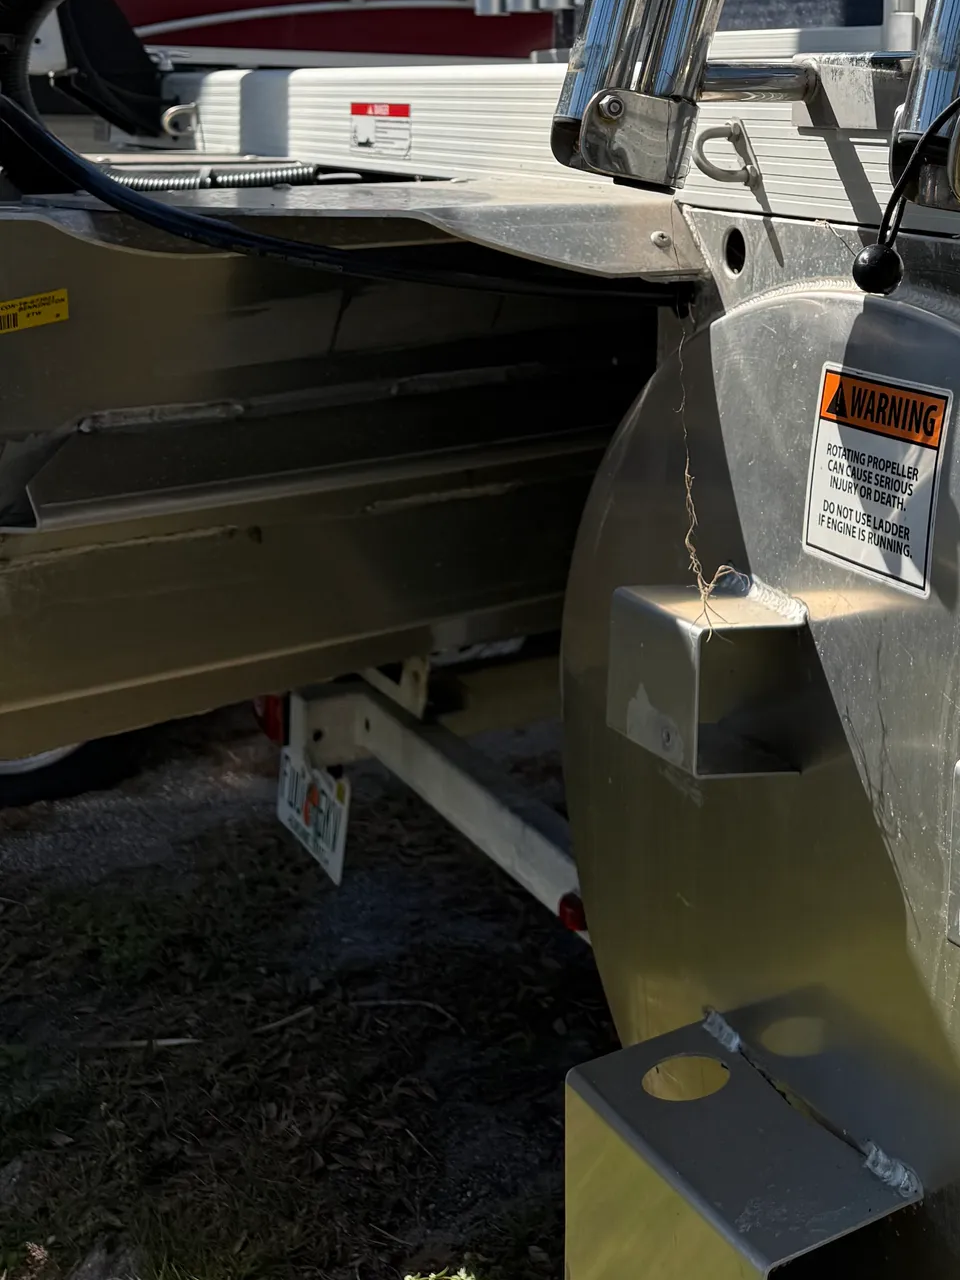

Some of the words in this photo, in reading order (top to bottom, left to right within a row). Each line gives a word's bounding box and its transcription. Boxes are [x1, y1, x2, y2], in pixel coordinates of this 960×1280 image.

[851, 386, 938, 437] WARNING
[827, 443, 866, 466] ROTATING
[867, 457, 919, 481] PROPELLER
[828, 459, 844, 474] CAN
[846, 465, 873, 484] CAUSE
[874, 473, 913, 497] SERIOUS
[830, 476, 858, 495] INJURY
[859, 485, 872, 500] OR
[874, 491, 906, 512] DEATH.
[818, 514, 825, 526] IF
[826, 517, 857, 537] ENGINE
[858, 527, 866, 541] IS
[868, 533, 913, 559] RUNNING.
[823, 500, 834, 513] DO
[836, 505, 854, 519] NOT
[855, 511, 871, 526] USE
[873, 518, 910, 541] LADDER
